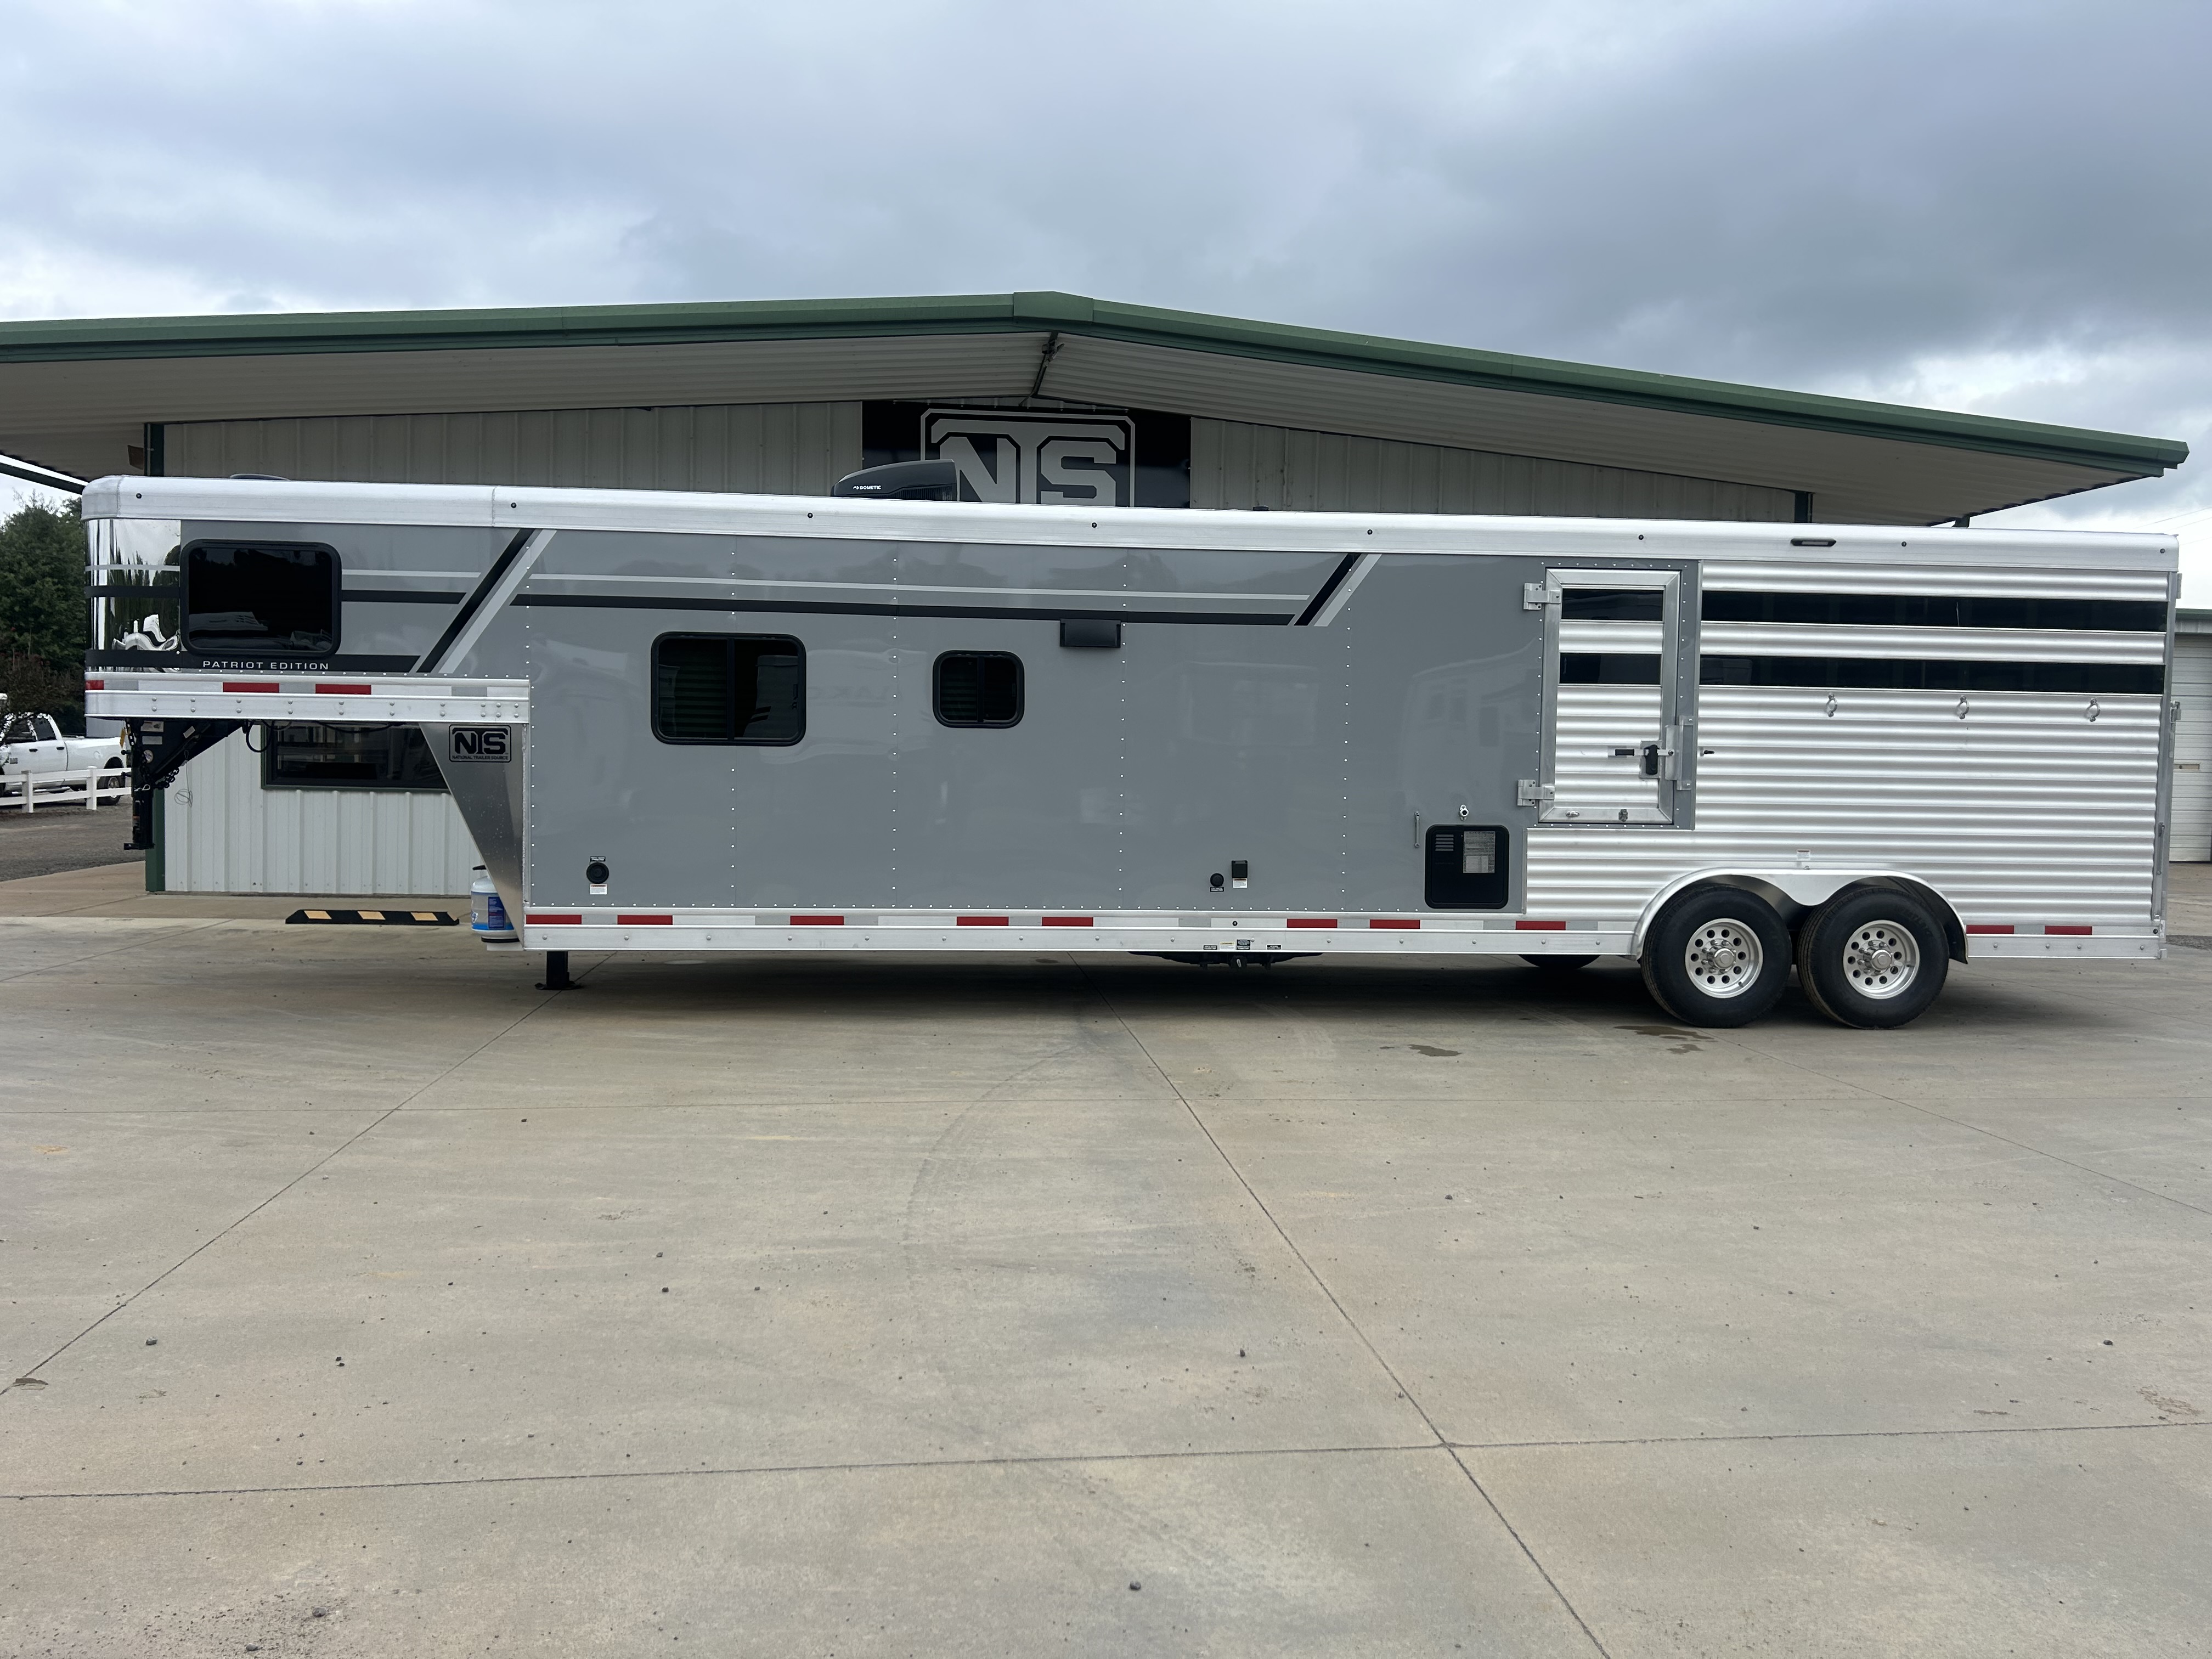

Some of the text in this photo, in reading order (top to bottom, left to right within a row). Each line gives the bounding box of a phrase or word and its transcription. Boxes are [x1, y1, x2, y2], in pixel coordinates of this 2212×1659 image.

[931, 419, 1125, 506] NTS
[203, 661, 329, 670] PATRIOT EDITION
[452, 727, 508, 754] NTS
